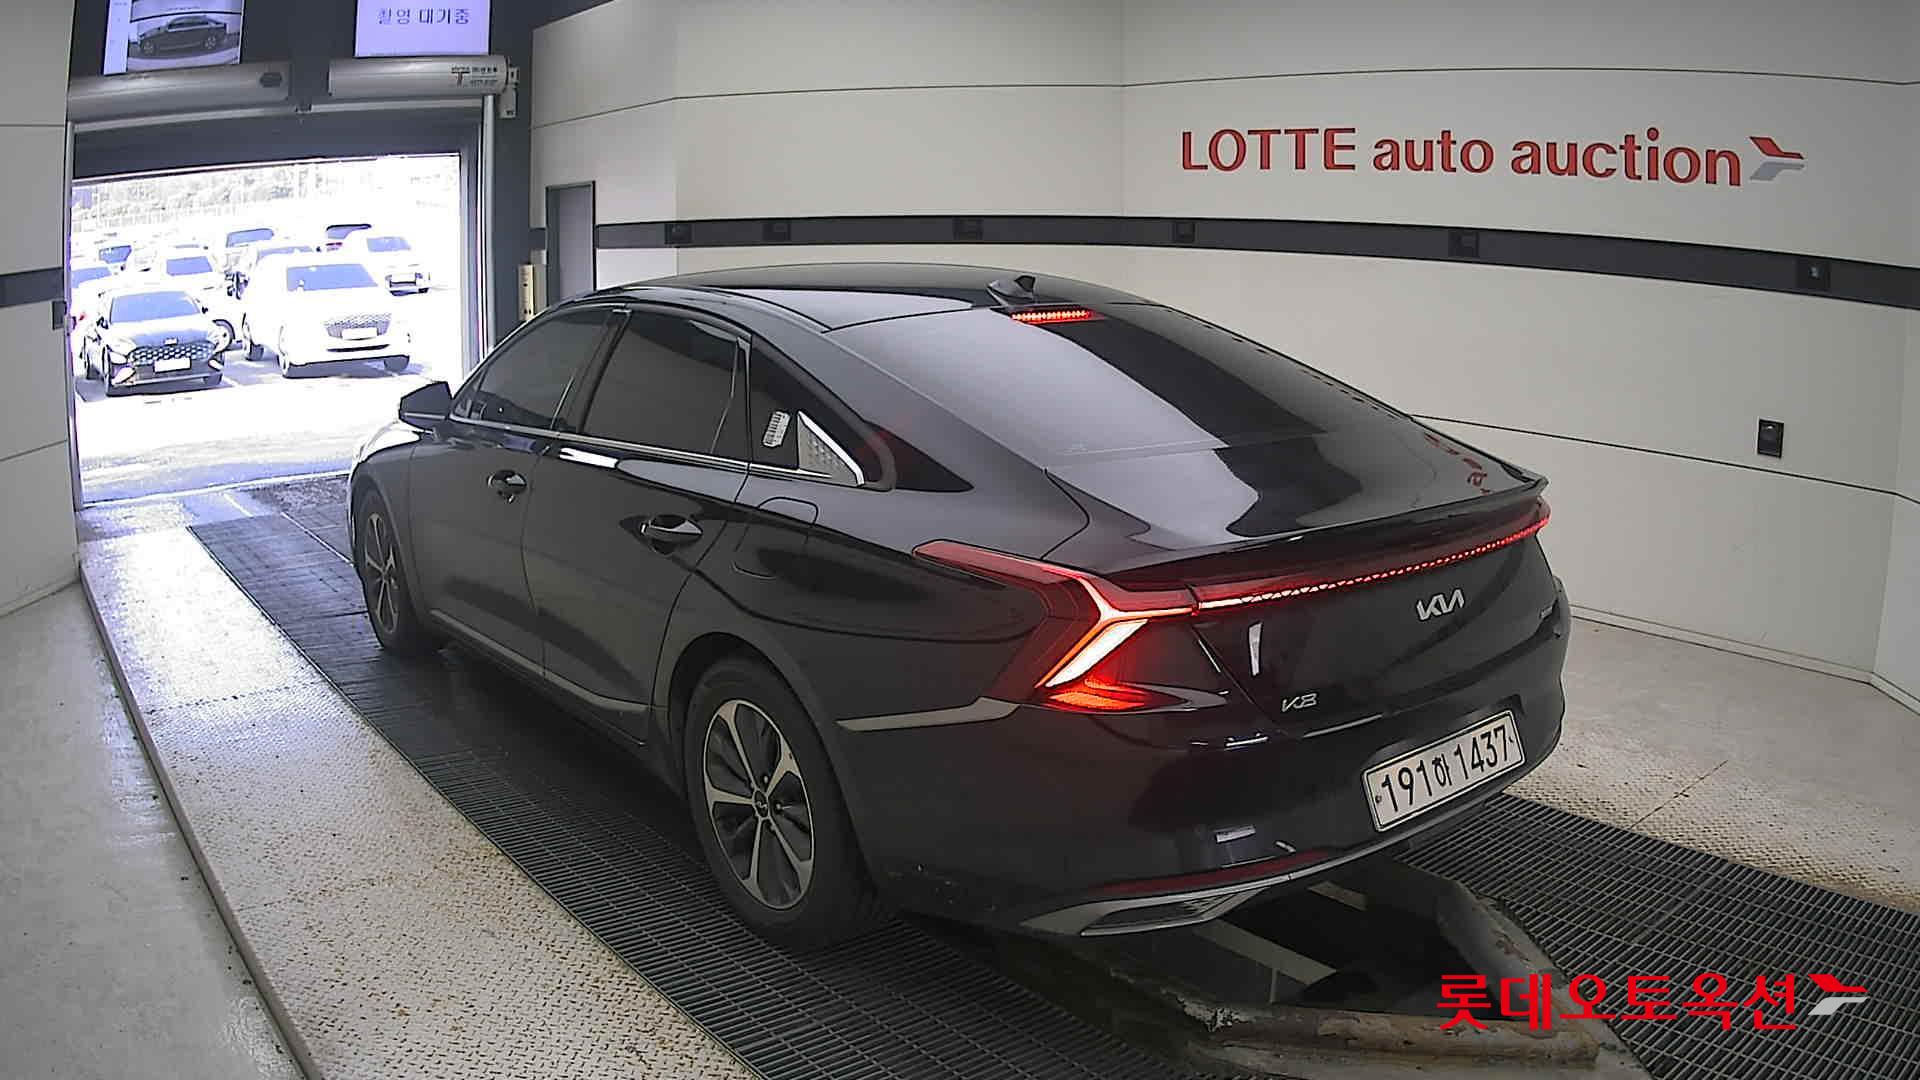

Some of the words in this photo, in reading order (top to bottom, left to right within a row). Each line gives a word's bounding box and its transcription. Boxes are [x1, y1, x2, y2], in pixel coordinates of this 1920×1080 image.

[418, 7, 470, 25] 대기중
[1181, 127, 1357, 171] LOTTE
[1372, 129, 1495, 174] auto
[1510, 127, 1742, 187] auction
[1416, 588, 1466, 622] KIA
[1280, 692, 1319, 713] K8
[1453, 726, 1511, 781] 1437
